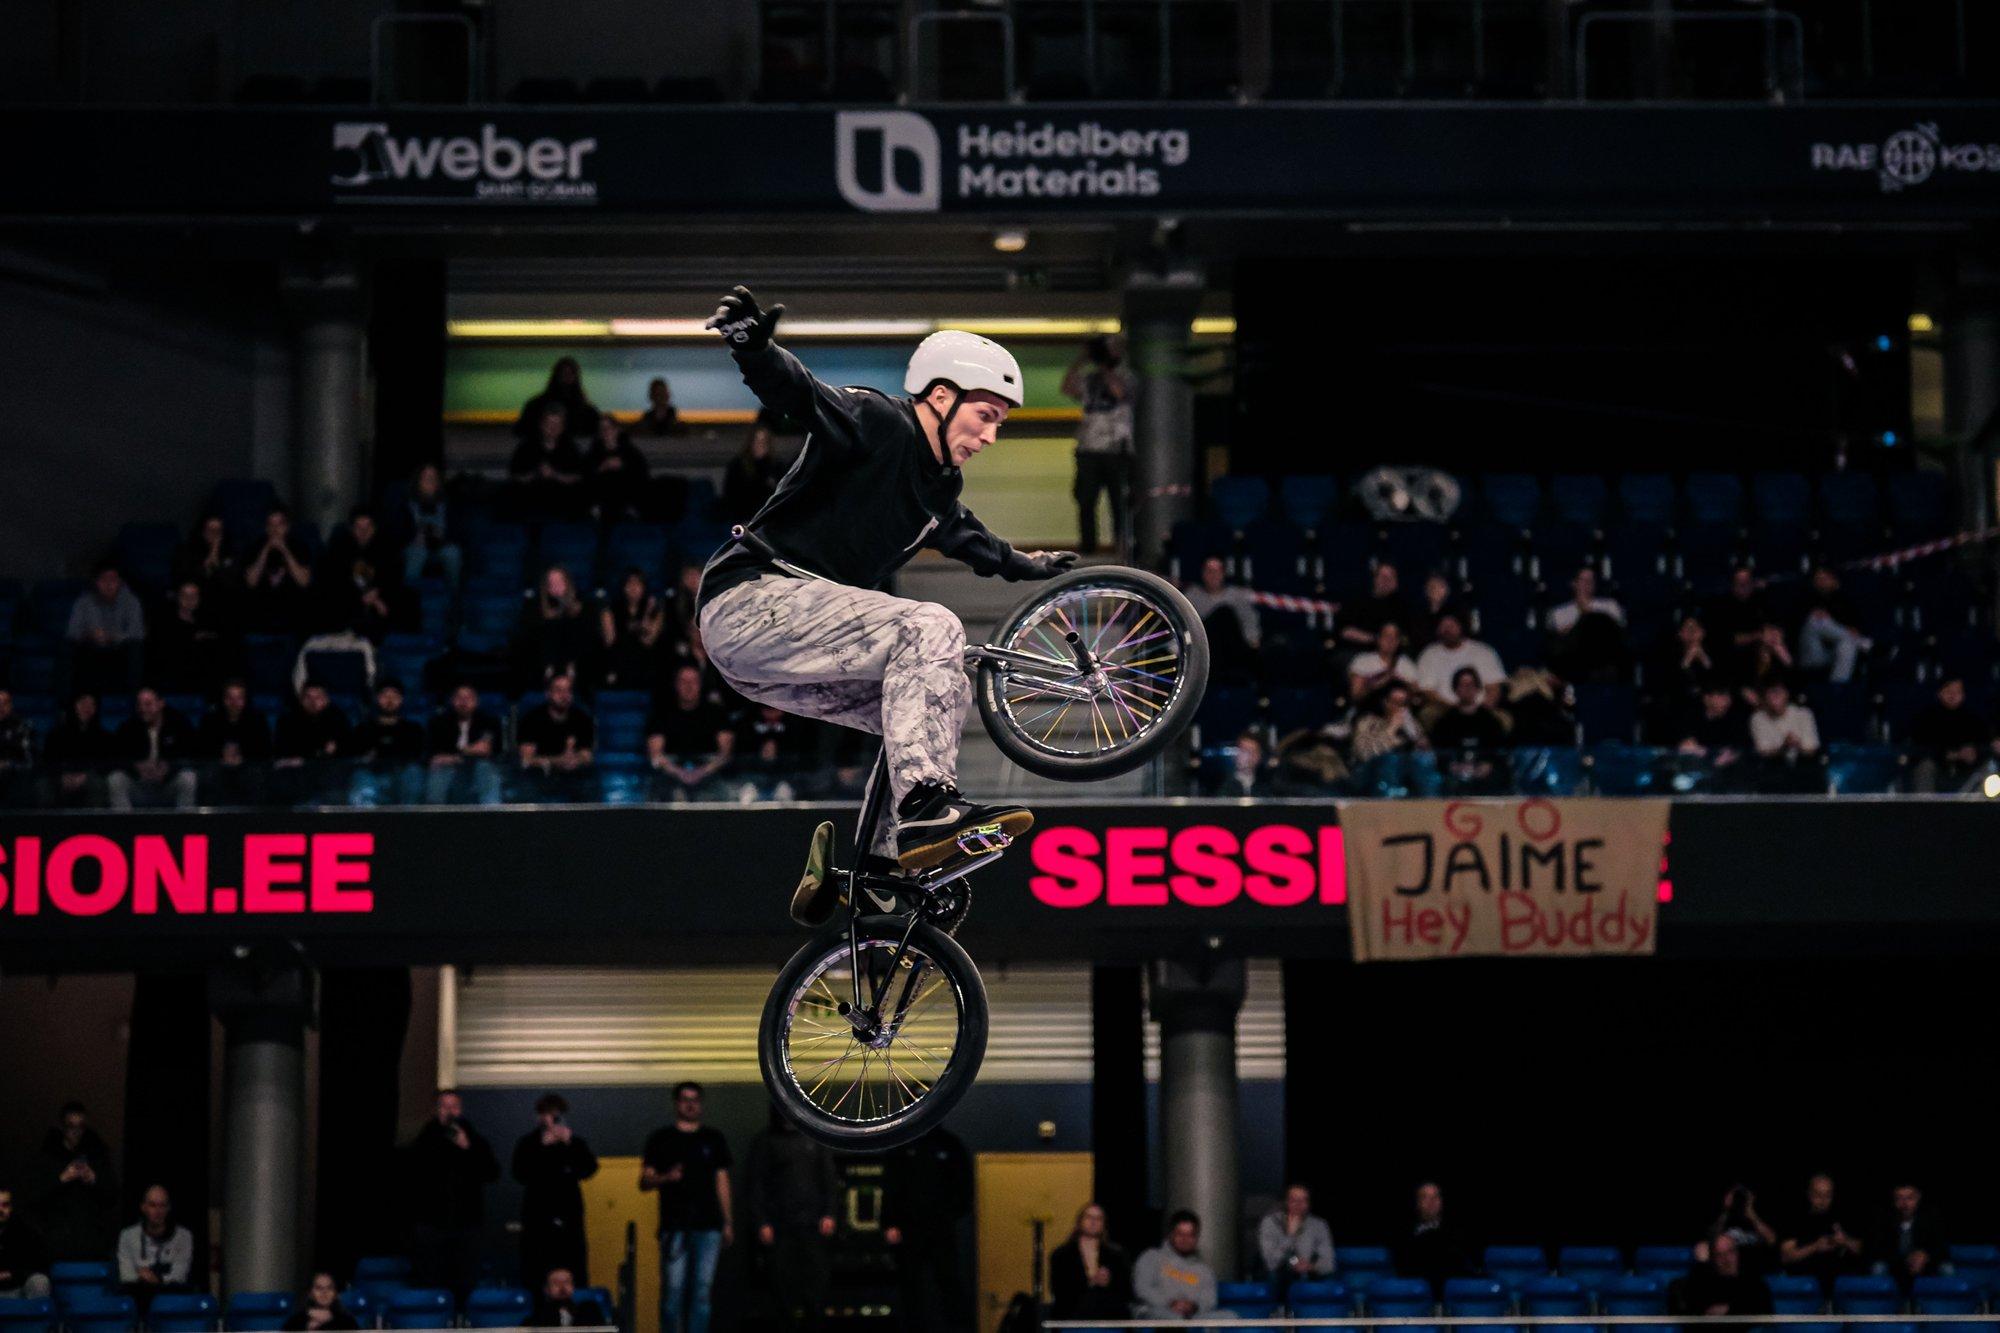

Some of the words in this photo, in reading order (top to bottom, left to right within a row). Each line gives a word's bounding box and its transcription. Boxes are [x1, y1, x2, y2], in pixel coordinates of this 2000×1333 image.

[384, 122, 596, 179] weber
[958, 121, 1190, 166] Heidelberg
[1811, 143, 1877, 170] RAE
[958, 161, 1161, 196] Materials
[0, 833, 374, 916] ION.EE
[1029, 825, 1347, 908] SESSI
[1382, 832, 1604, 897] JAIME
[1382, 898, 1470, 953] Hey
[1497, 889, 1651, 952] Buddy
